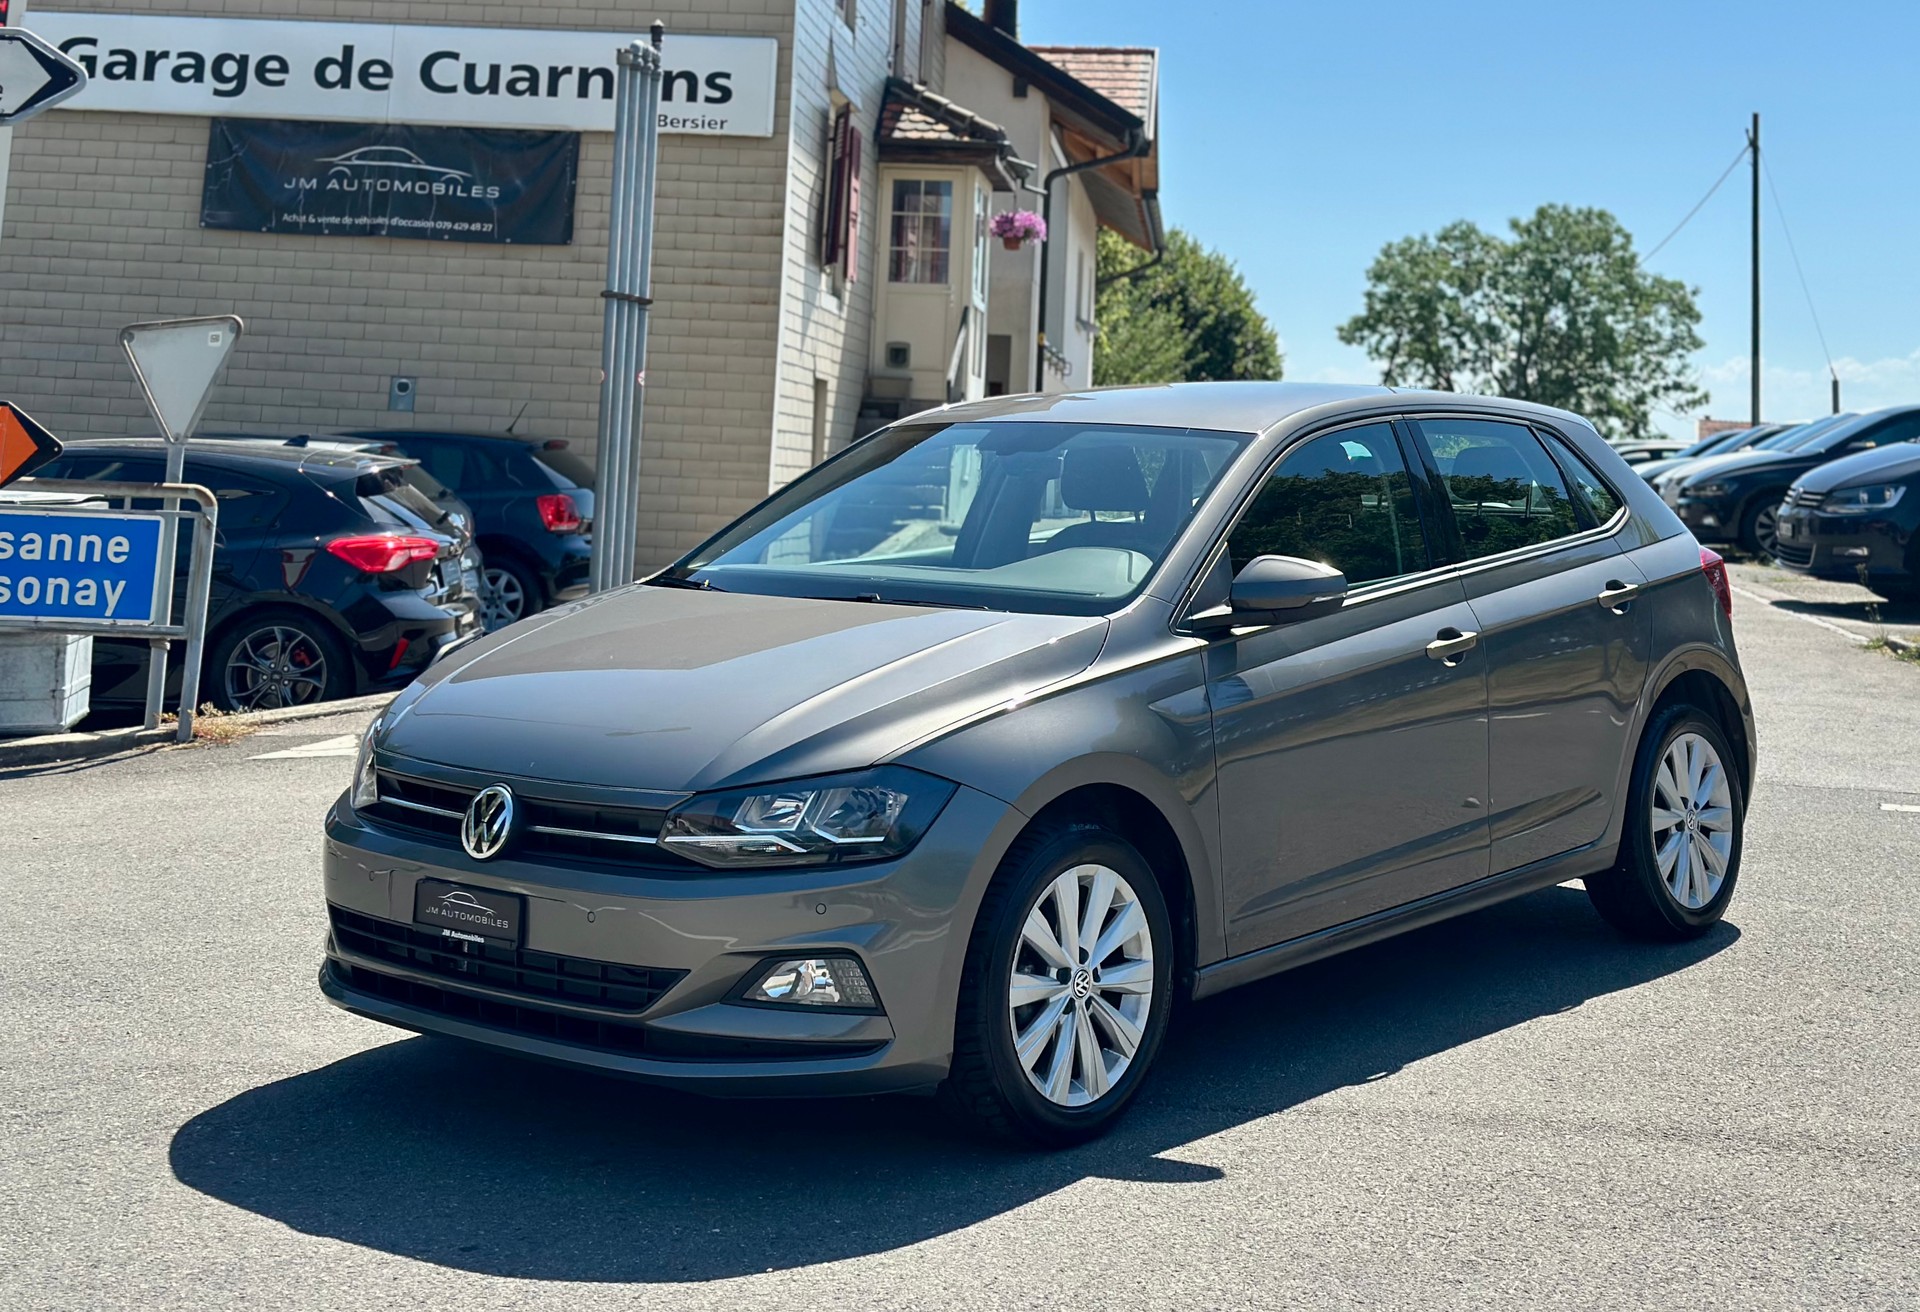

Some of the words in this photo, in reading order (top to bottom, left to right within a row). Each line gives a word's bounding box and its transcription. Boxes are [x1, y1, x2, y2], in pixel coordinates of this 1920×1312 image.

[314, 44, 394, 91] de
[419, 50, 733, 105] Cuarnns
[657, 113, 728, 130] Bersier
[284, 177, 317, 190] JM
[326, 178, 500, 198] AUTOMOBILES
[282, 213, 306, 223] Achat
[317, 216, 340, 225] vente
[341, 216, 353, 225] de
[390, 217, 435, 229] d'occasion
[436, 221, 452, 230] 079
[453, 222, 469, 231] 429
[482, 223, 493, 232] 27
[0, 531, 130, 564] sanne
[426, 906, 439, 915] JM
[441, 910, 509, 929] AUTOMOBILES
[451, 930, 485, 943] Automobiles
